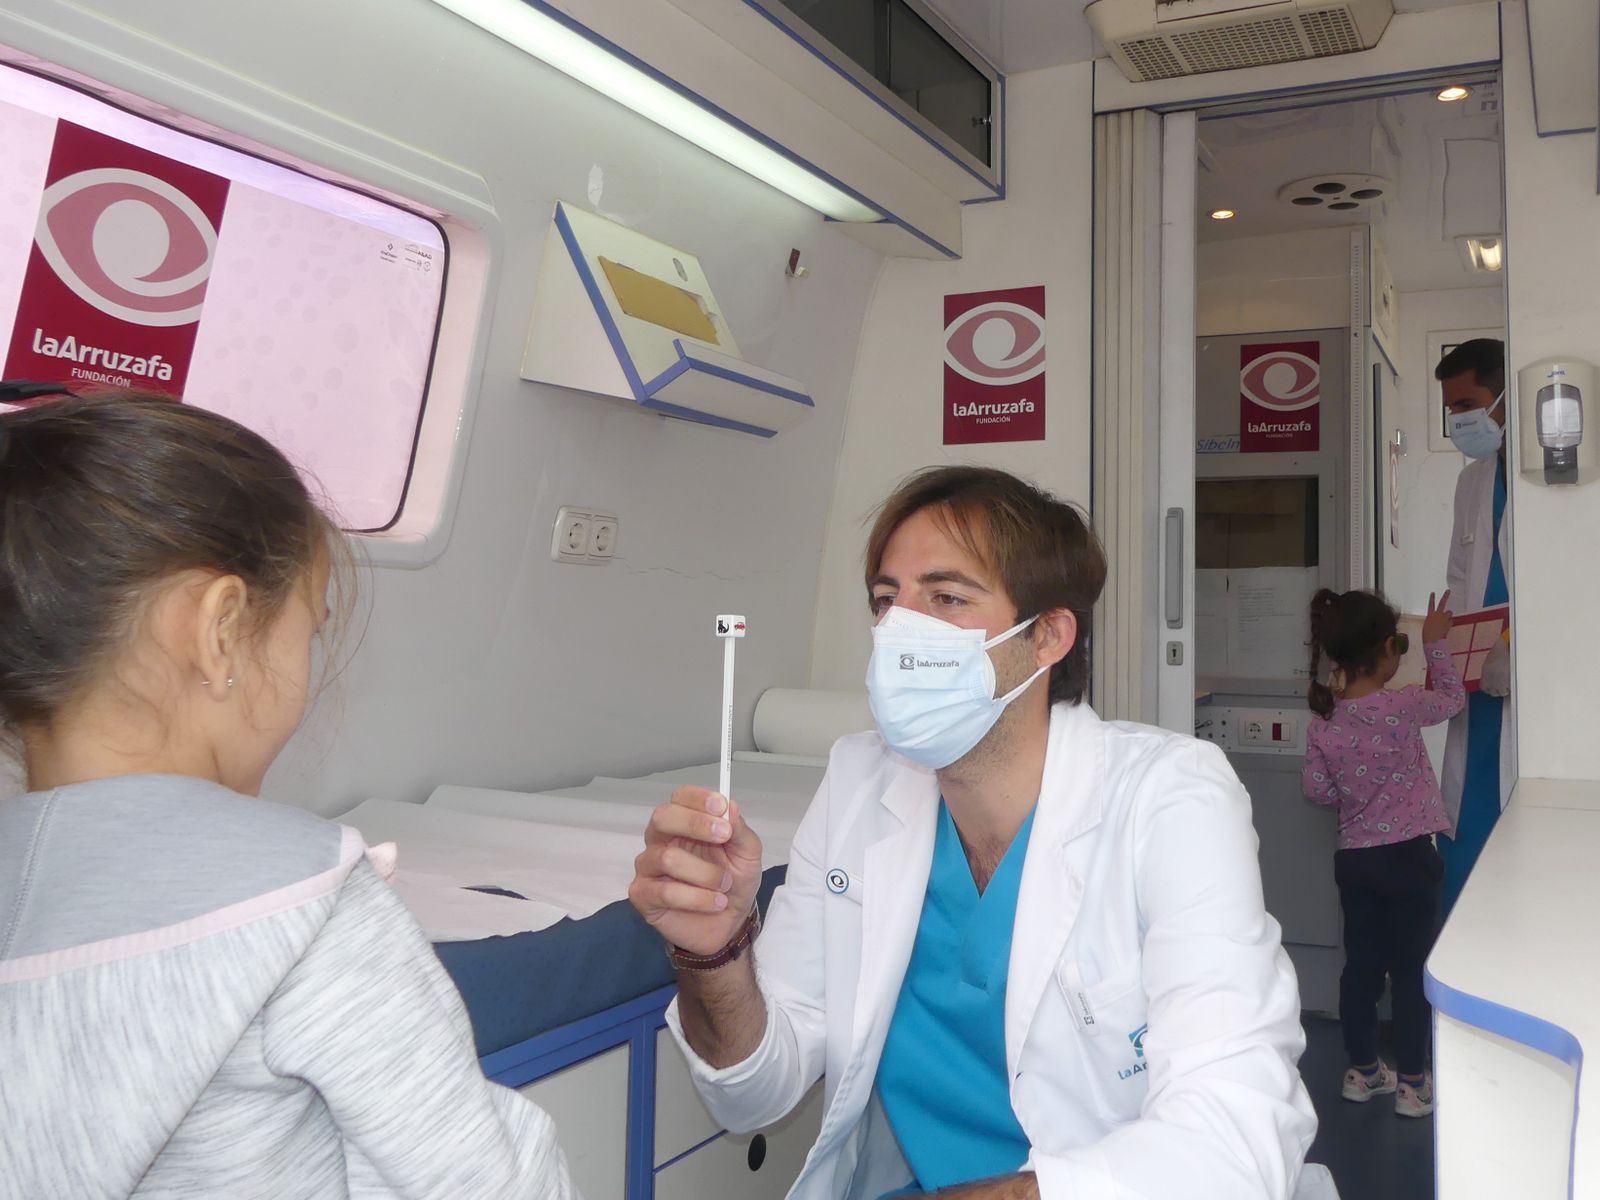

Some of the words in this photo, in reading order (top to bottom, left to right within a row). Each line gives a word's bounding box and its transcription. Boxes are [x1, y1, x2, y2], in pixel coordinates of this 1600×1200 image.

[32, 327, 174, 381] laArruzafa
[71, 367, 132, 388] FUNDACIÓN
[953, 398, 1035, 417] laArruzafa
[976, 416, 1011, 425] FUNDACIÓN
[1247, 420, 1312, 433] laArruzafa
[916, 659, 960, 668] laArruzafa
